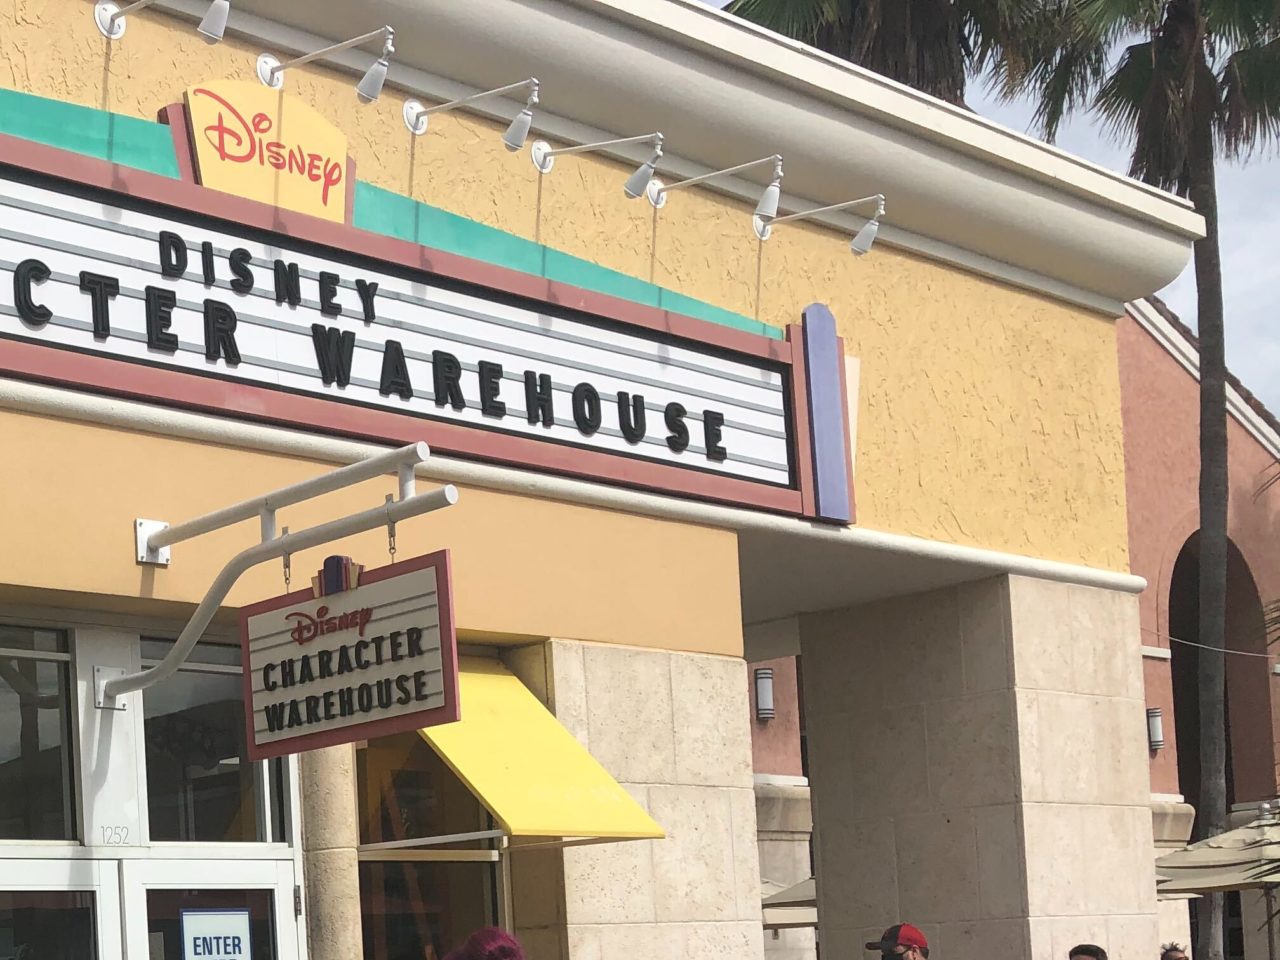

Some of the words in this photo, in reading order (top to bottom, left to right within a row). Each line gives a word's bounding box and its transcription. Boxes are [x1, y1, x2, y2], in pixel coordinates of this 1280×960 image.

[193, 88, 342, 205] Disney
[158, 231, 379, 323] DISNEY
[311, 324, 727, 461] WAREHOUSE
[284, 606, 374, 646] Disney
[263, 627, 424, 692] CHARACTER
[264, 670, 428, 732] WAREHOUSE
[100, 825, 130, 845] 1252
[193, 936, 242, 956] ENTER
